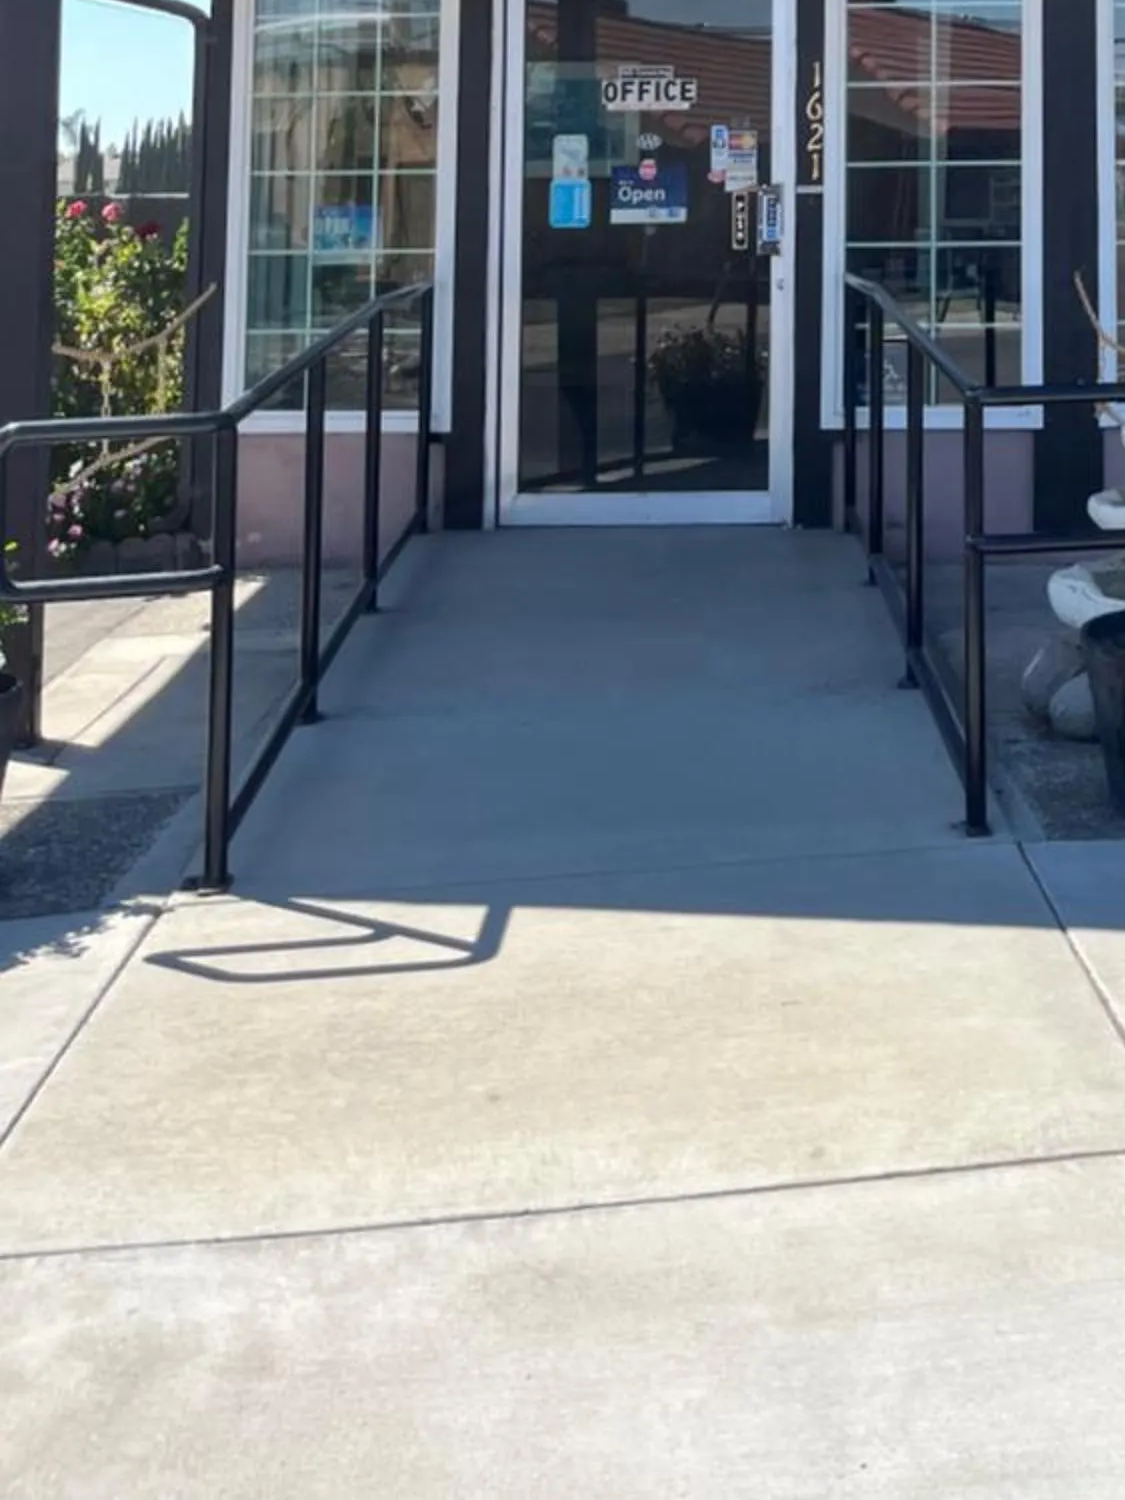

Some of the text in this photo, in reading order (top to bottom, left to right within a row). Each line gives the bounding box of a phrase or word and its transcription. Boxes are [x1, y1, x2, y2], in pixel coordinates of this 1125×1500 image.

[603, 79, 694, 103] OFFICE
[806, 61, 824, 181] 1621
[617, 185, 667, 205] Open
